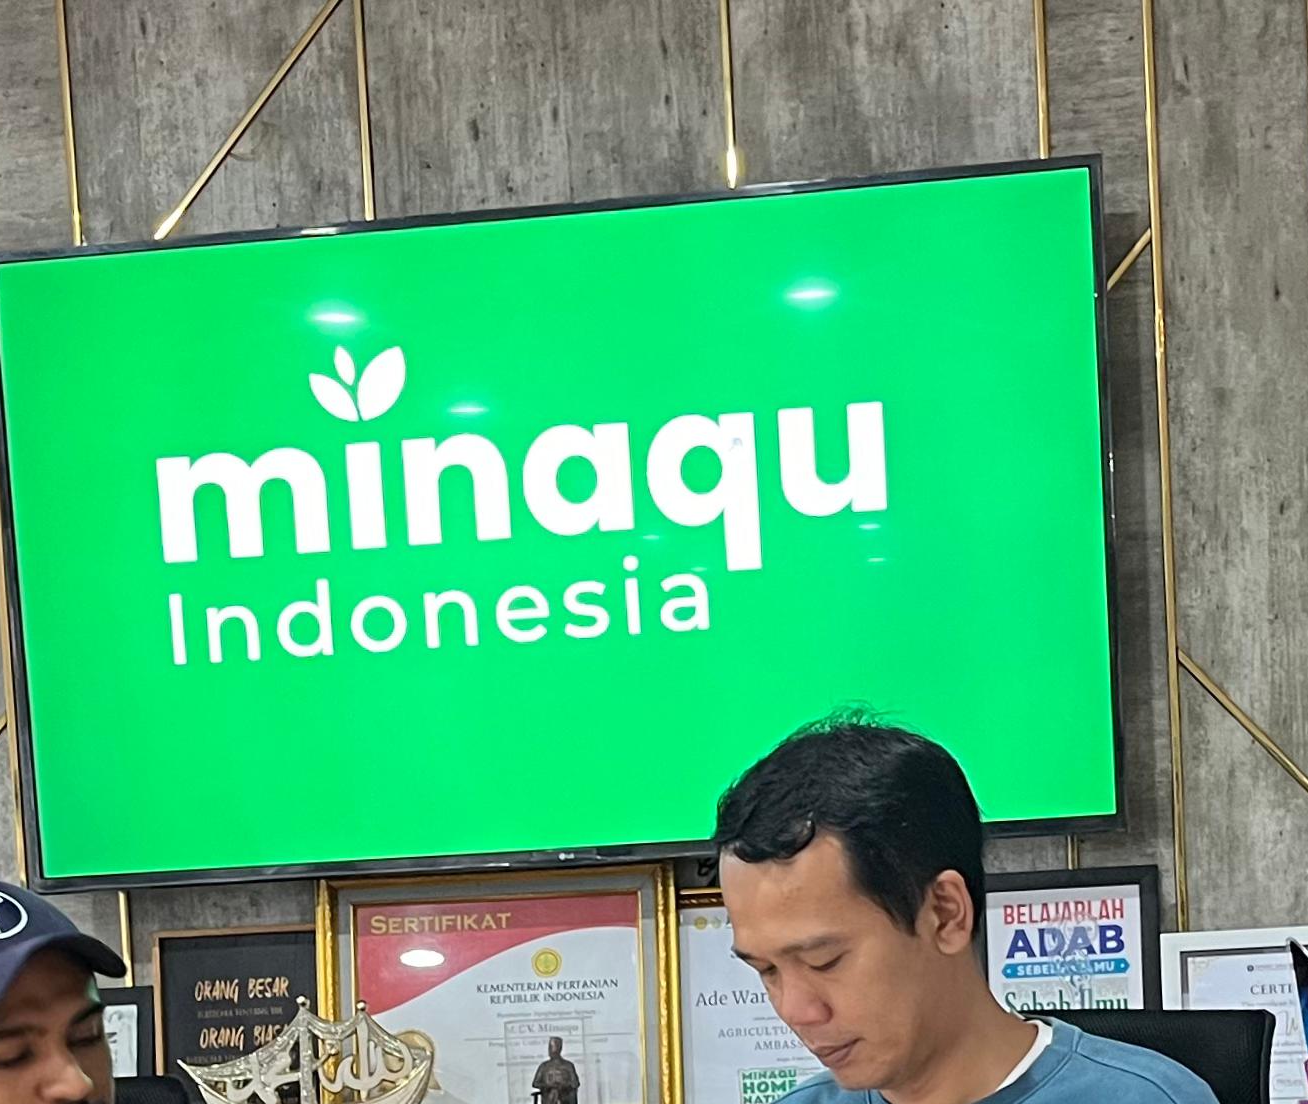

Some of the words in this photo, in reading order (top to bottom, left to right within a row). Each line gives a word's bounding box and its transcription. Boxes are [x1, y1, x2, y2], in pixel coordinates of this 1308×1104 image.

[156, 401, 889, 571] minaqu
[169, 555, 711, 666] Indonesia
[1003, 897, 1124, 925] BELAJARLAH
[370, 912, 511, 934] SERTIFIKAT
[1006, 924, 1125, 959] ADAB
[1017, 962, 1077, 976] SEBEL
[194, 978, 239, 1004] ORANG
[247, 976, 290, 999] BESAR
[476, 981, 554, 993] KEMENTERIAN
[557, 979, 619, 990] PERTANIAN
[1250, 984, 1293, 995] CERTI
[490, 993, 540, 1004] REPUBLIK
[543, 991, 605, 1002] INDONESIA
[695, 989, 728, 1007] Ade
[731, 989, 768, 1005] War
[199, 1026, 244, 1051] ORANG
[253, 1024, 288, 1046] BIAS
[754, 1039, 804, 1051] AMBASS
[741, 1069, 797, 1081] MINAQU
[742, 1079, 797, 1094] HOME
